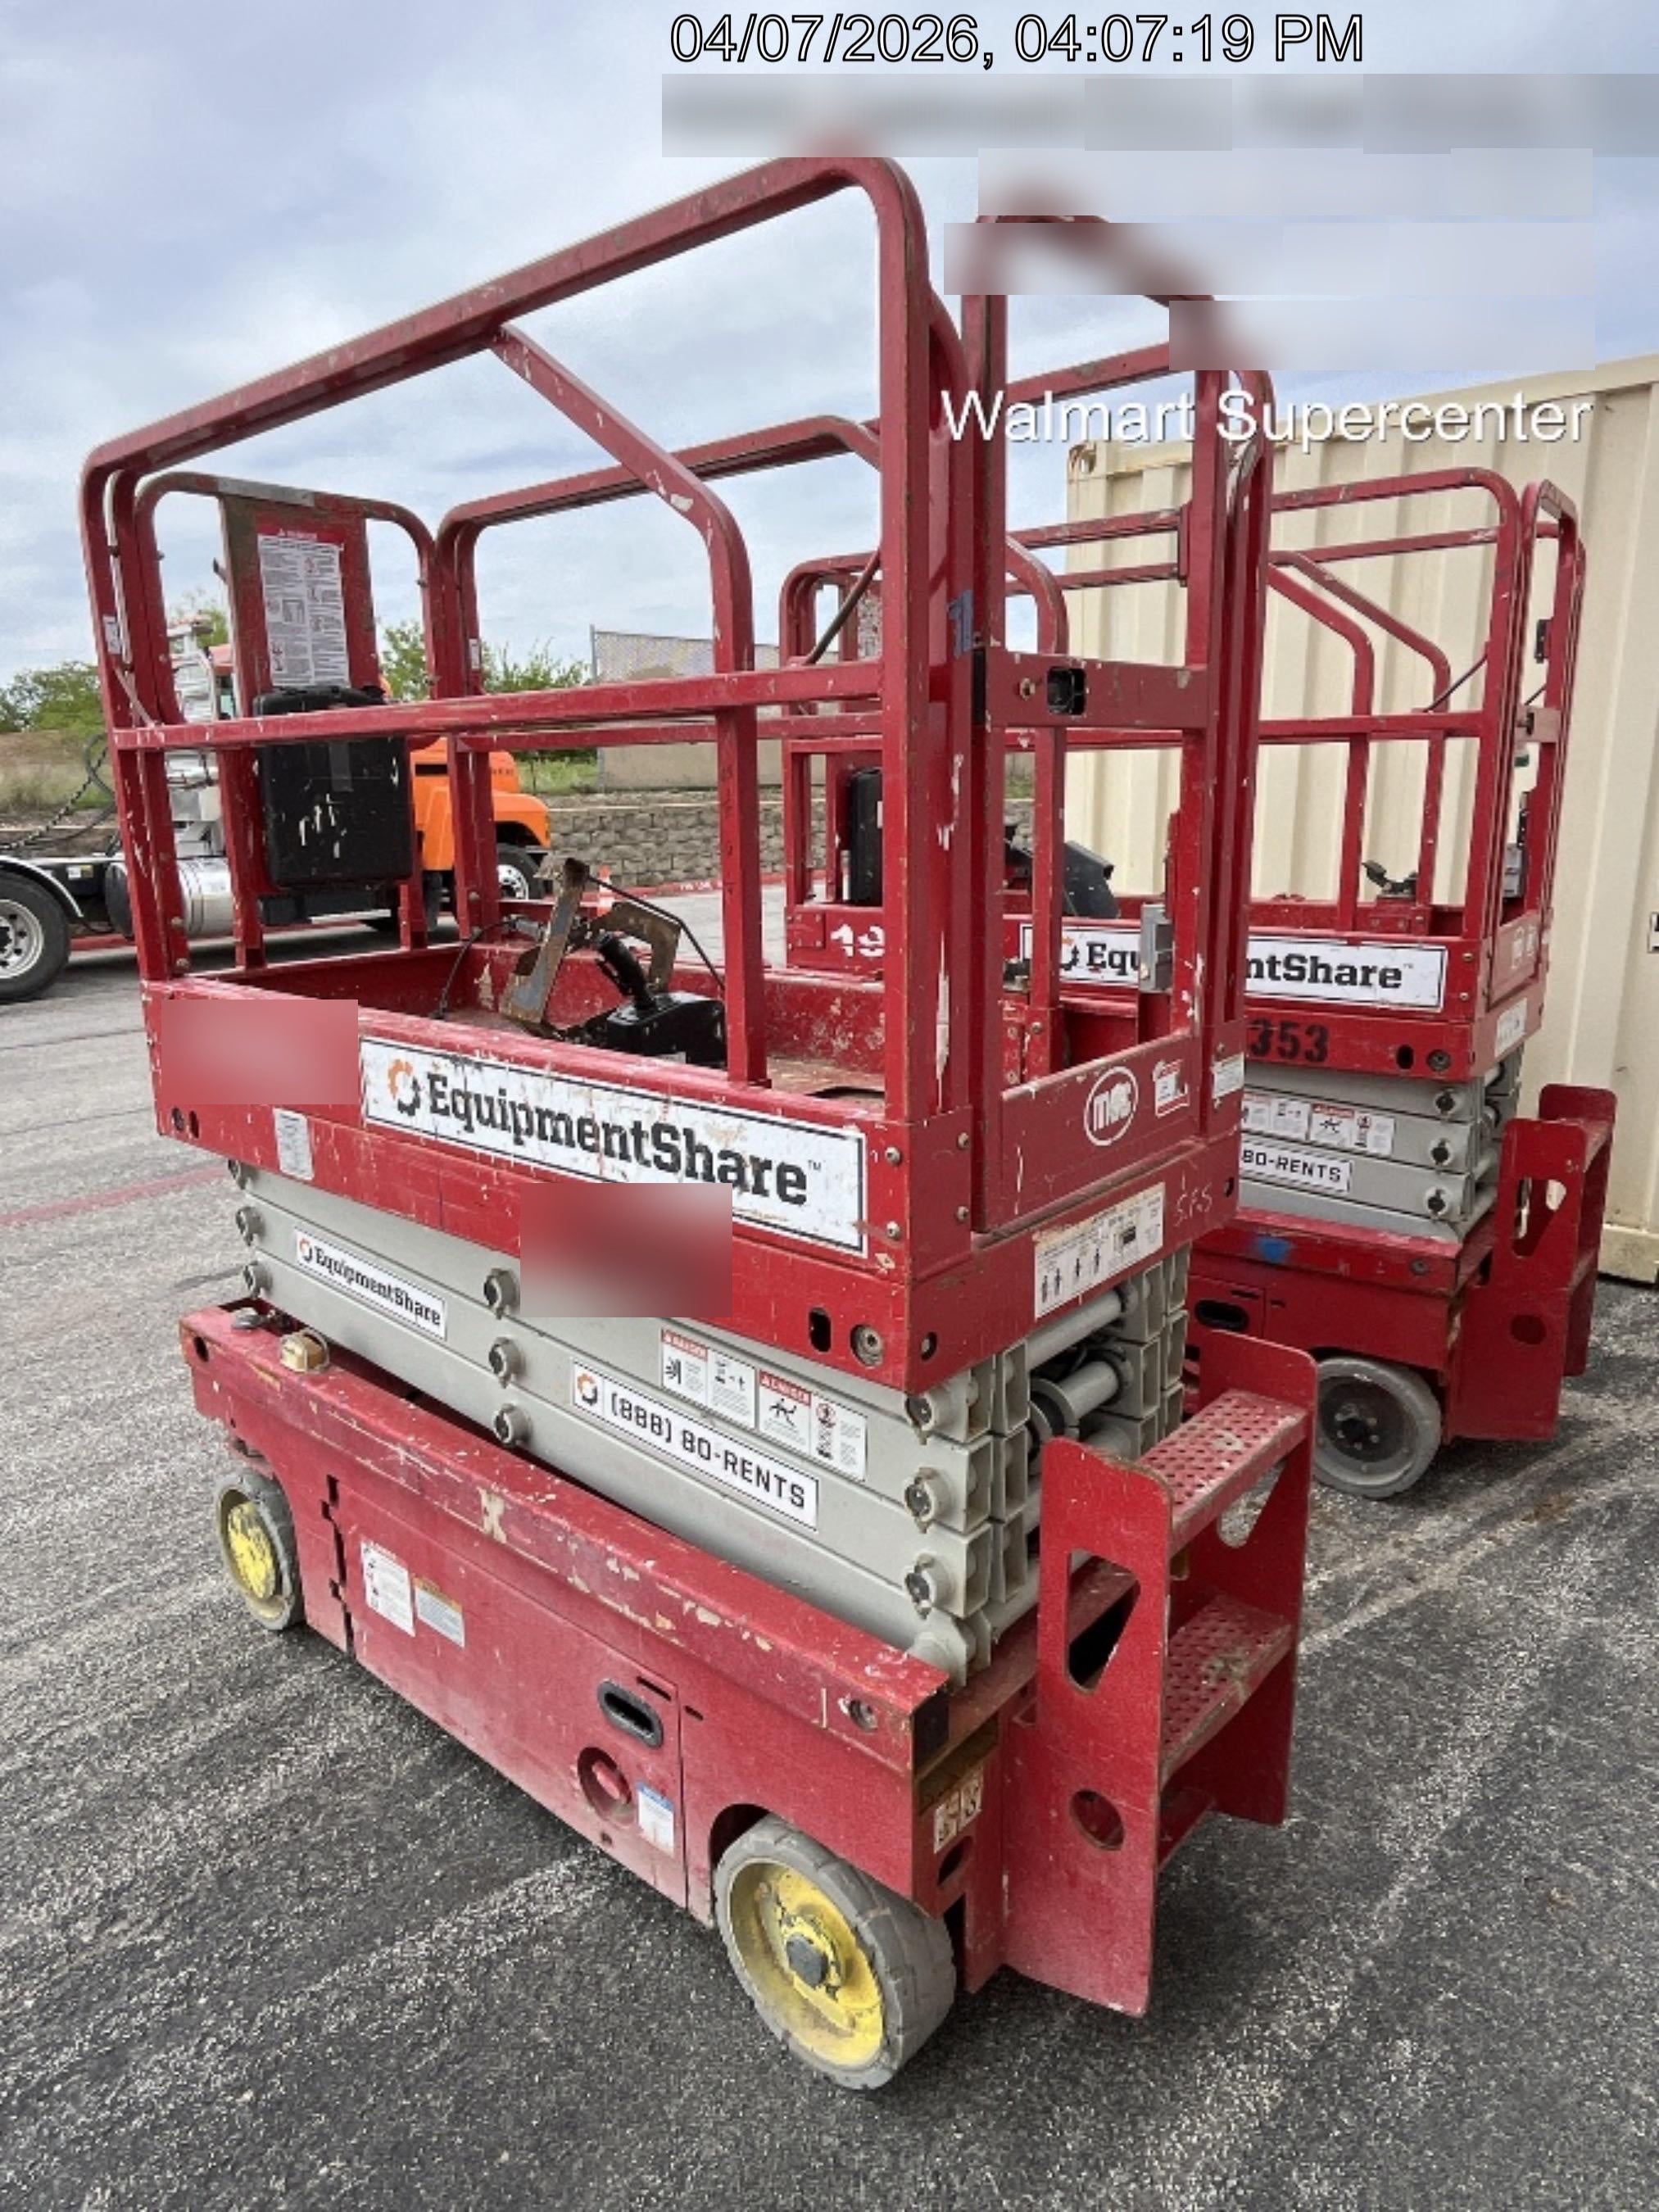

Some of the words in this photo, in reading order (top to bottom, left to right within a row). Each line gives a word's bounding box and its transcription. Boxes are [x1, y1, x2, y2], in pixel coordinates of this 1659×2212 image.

[314, 1245, 441, 1326] EquipmentShare
[610, 1392, 673, 1444] (888)
[682, 1429, 805, 1509] 80-RENTS
